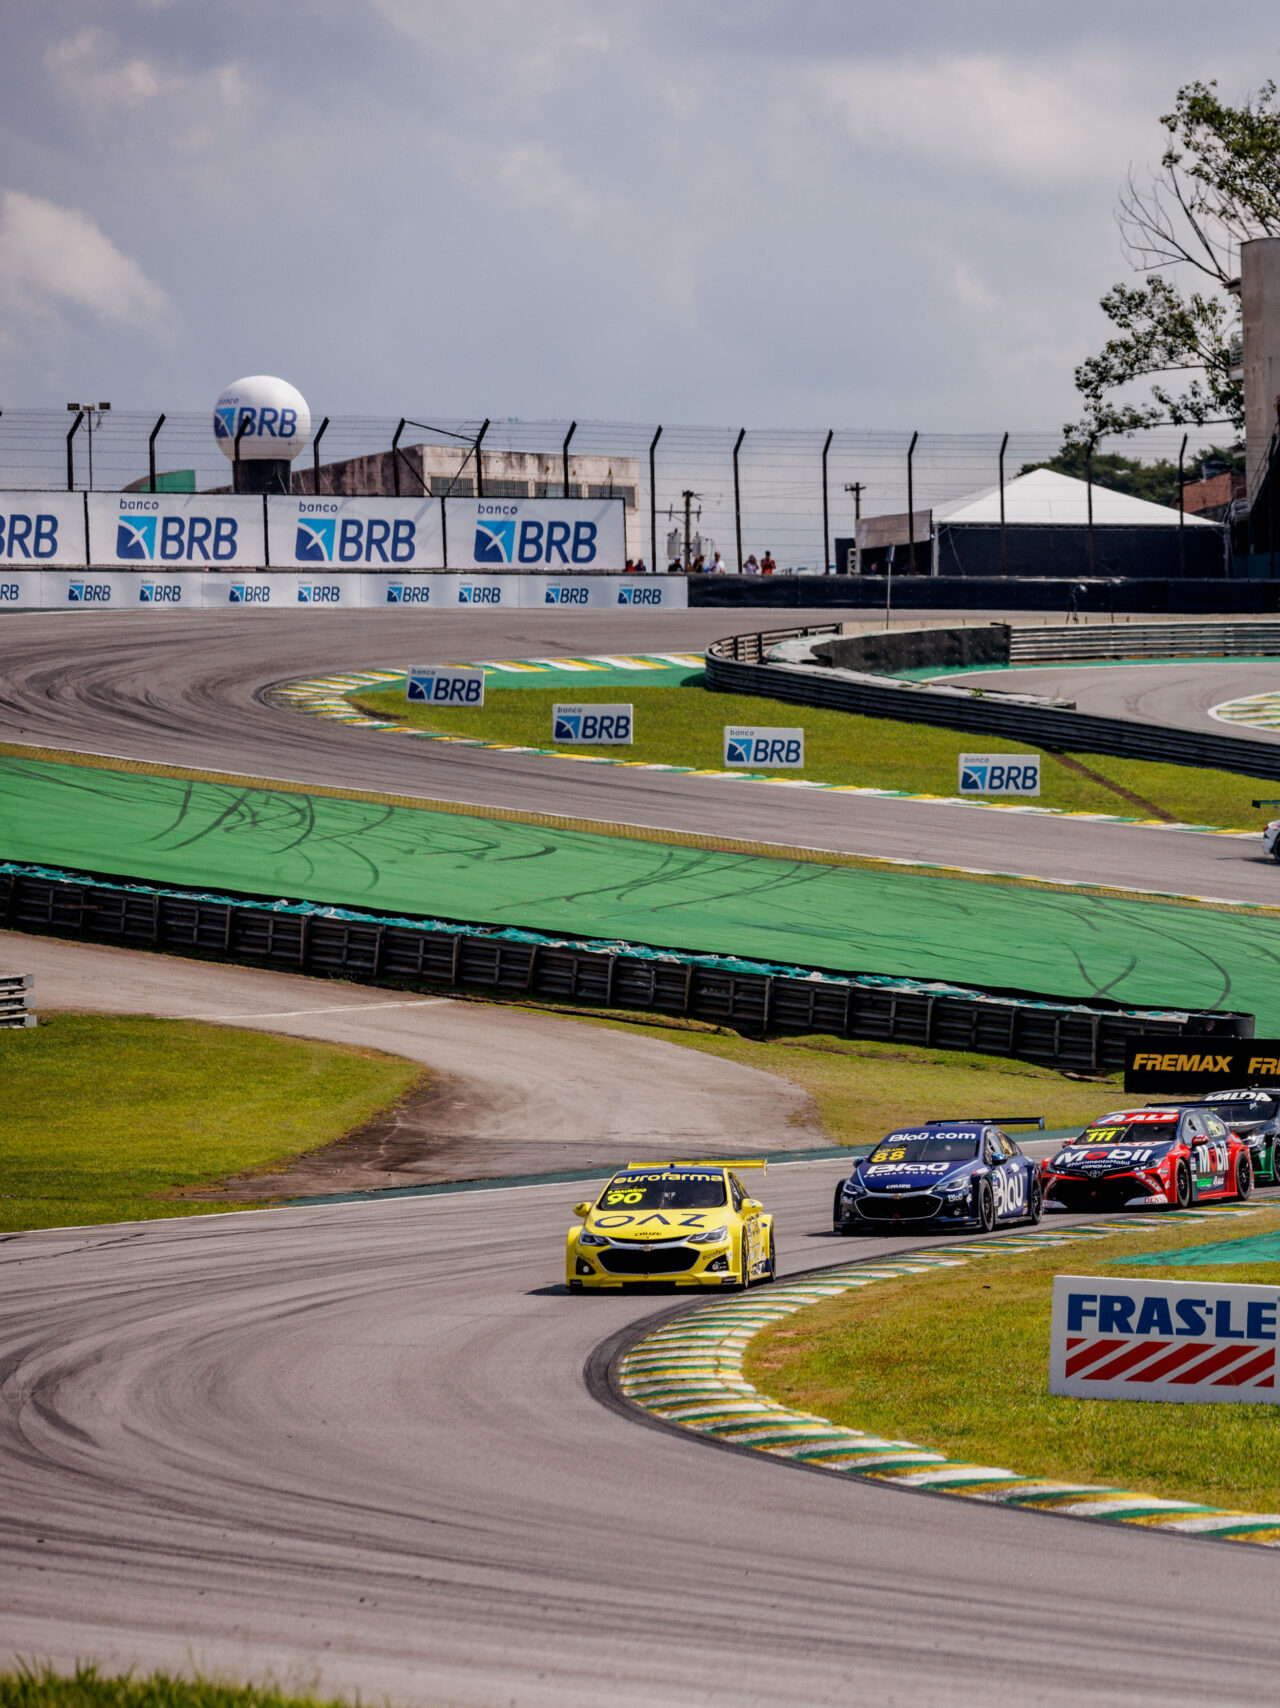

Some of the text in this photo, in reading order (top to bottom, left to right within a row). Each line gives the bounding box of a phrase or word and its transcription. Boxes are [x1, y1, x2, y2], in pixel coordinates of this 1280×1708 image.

[237, 407, 297, 438] BRB
[119, 498, 159, 510] banco
[299, 501, 338, 513] banco
[478, 503, 518, 515] banco
[0, 514, 58, 558] RB
[160, 517, 238, 560] BRB
[339, 519, 416, 562] BRB
[518, 521, 598, 564] BRB
[84, 585, 111, 601] BRB
[154, 586, 181, 602] BRB
[244, 586, 270, 602] BRB
[312, 586, 340, 602] BRB
[403, 587, 430, 603] BRB
[472, 588, 500, 603] BRB
[560, 588, 589, 604] BRB
[632, 589, 662, 604] BRB
[434, 678, 481, 702] BRB
[581, 716, 630, 739] BRB
[730, 729, 754, 737] banco
[753, 740, 801, 763] BRB
[964, 756, 990, 764] banco
[988, 766, 1038, 790] BRB
[1133, 1053, 1234, 1073] FREMAX
[1204, 1092, 1272, 1102] VALDA
[1125, 1114, 1178, 1122] ALE
[1087, 1131, 1116, 1142] 111
[872, 1151, 905, 1162] 88
[1054, 1149, 1153, 1166] Mobil
[1196, 1140, 1229, 1173] Mobil
[614, 1172, 723, 1184] eurofarma
[607, 1193, 643, 1205] 90
